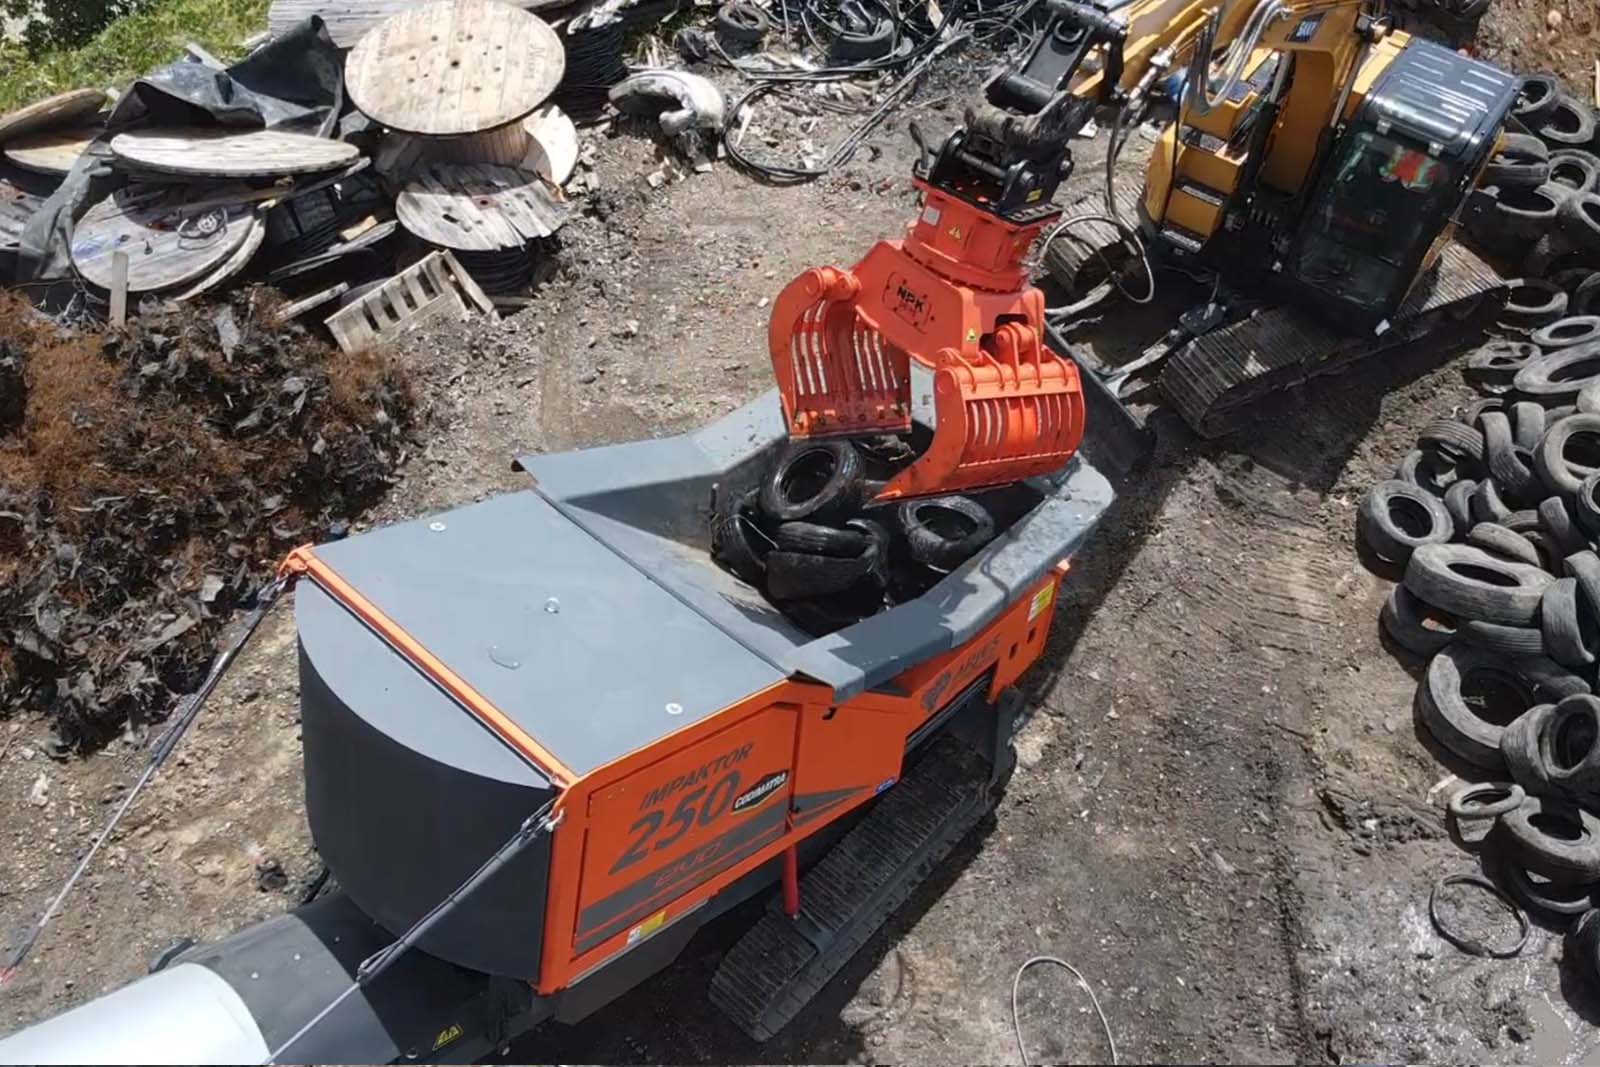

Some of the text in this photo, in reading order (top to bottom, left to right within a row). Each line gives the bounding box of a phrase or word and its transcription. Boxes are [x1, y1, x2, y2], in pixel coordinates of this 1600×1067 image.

[897, 286, 924, 312] NPK
[639, 742, 755, 811] IMPAKTOR
[608, 770, 742, 875] 250
